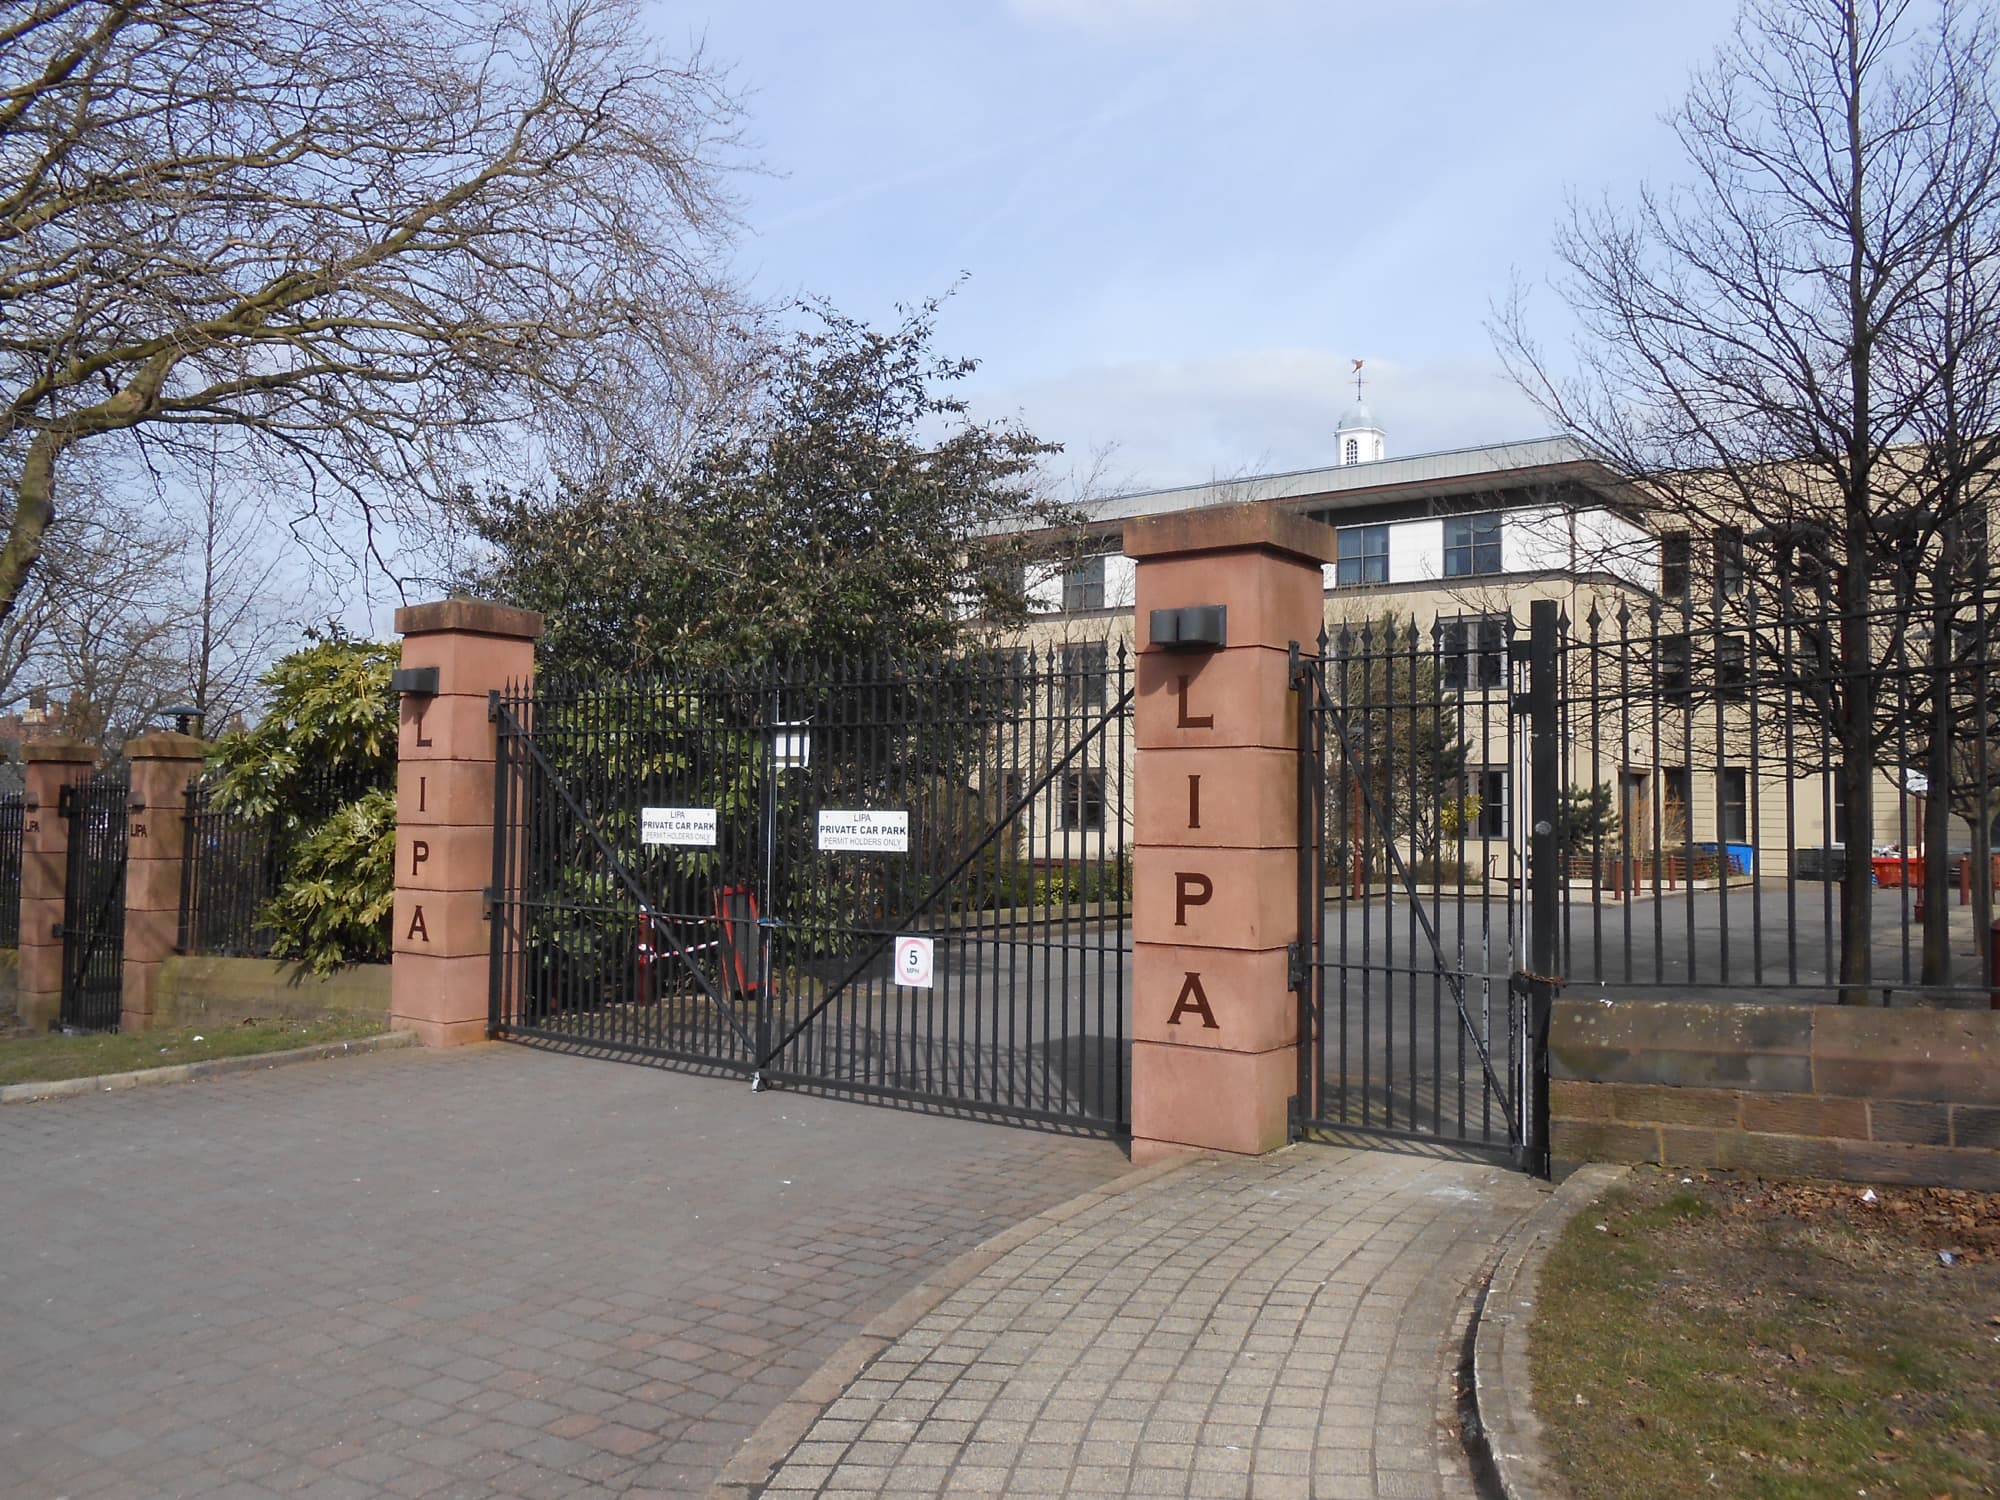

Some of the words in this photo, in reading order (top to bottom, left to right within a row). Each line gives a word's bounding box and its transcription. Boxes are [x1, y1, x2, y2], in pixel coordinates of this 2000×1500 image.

[670, 810, 686, 819] LIPA
[853, 813, 872, 822] LIPA
[130, 823, 148, 838] LIPA
[643, 821, 673, 830] PRIVATE
[675, 822, 692, 830] CAR
[693, 822, 715, 831] PARK
[820, 825, 857, 834] PRIVATE
[860, 826, 879, 835] CAR
[881, 826, 906, 836] PARK
[646, 831, 666, 840] PERMIT
[667, 832, 694, 840] HOLDERS
[695, 833, 711, 841] ONLY
[824, 837, 849, 845] PERMIT
[850, 837, 882, 846] HOLDERS
[883, 838, 902, 847] ONLY
[909, 950, 918, 965] 5
